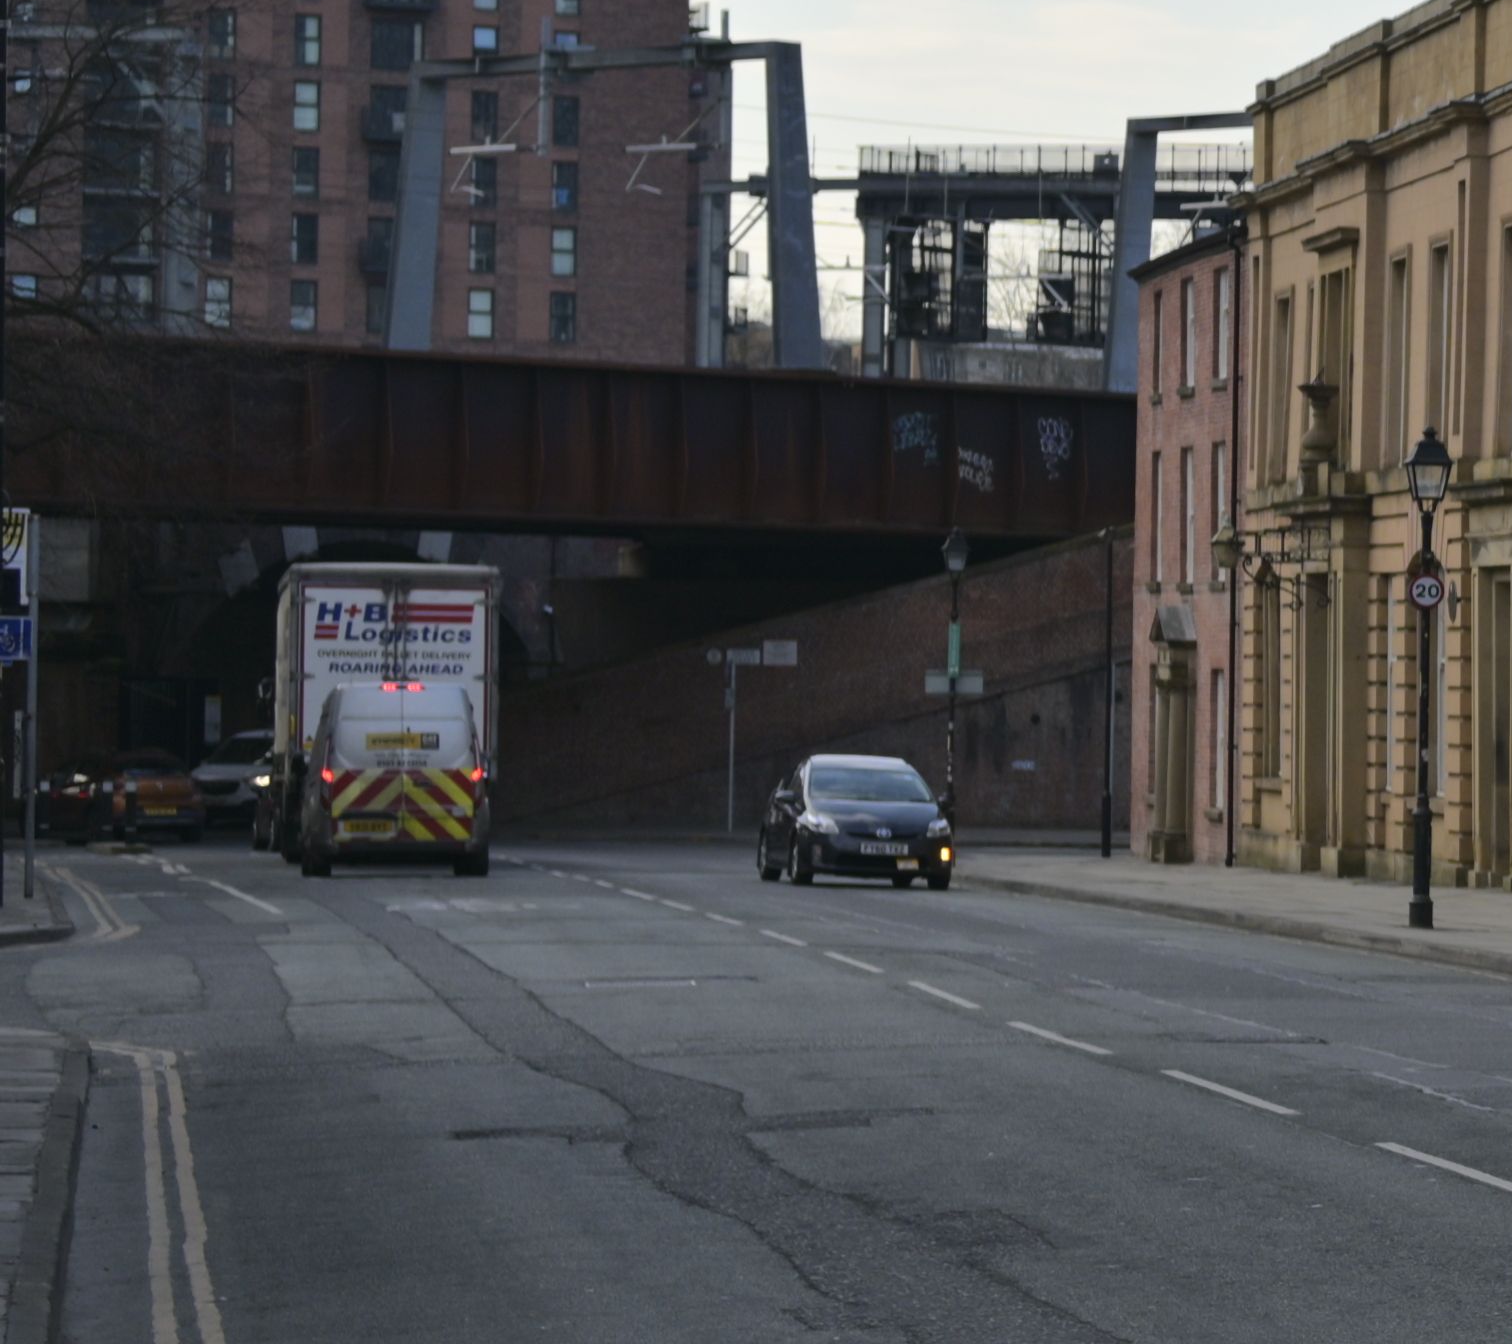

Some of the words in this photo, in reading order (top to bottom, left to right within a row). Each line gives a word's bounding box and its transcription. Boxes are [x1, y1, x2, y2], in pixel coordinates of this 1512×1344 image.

[1415, 583, 1440, 599] 20
[344, 621, 472, 646] Logistics
[317, 650, 377, 659] OVERNIGHT
[422, 651, 471, 661] DELIVERY
[408, 663, 464, 675] AHEAD
